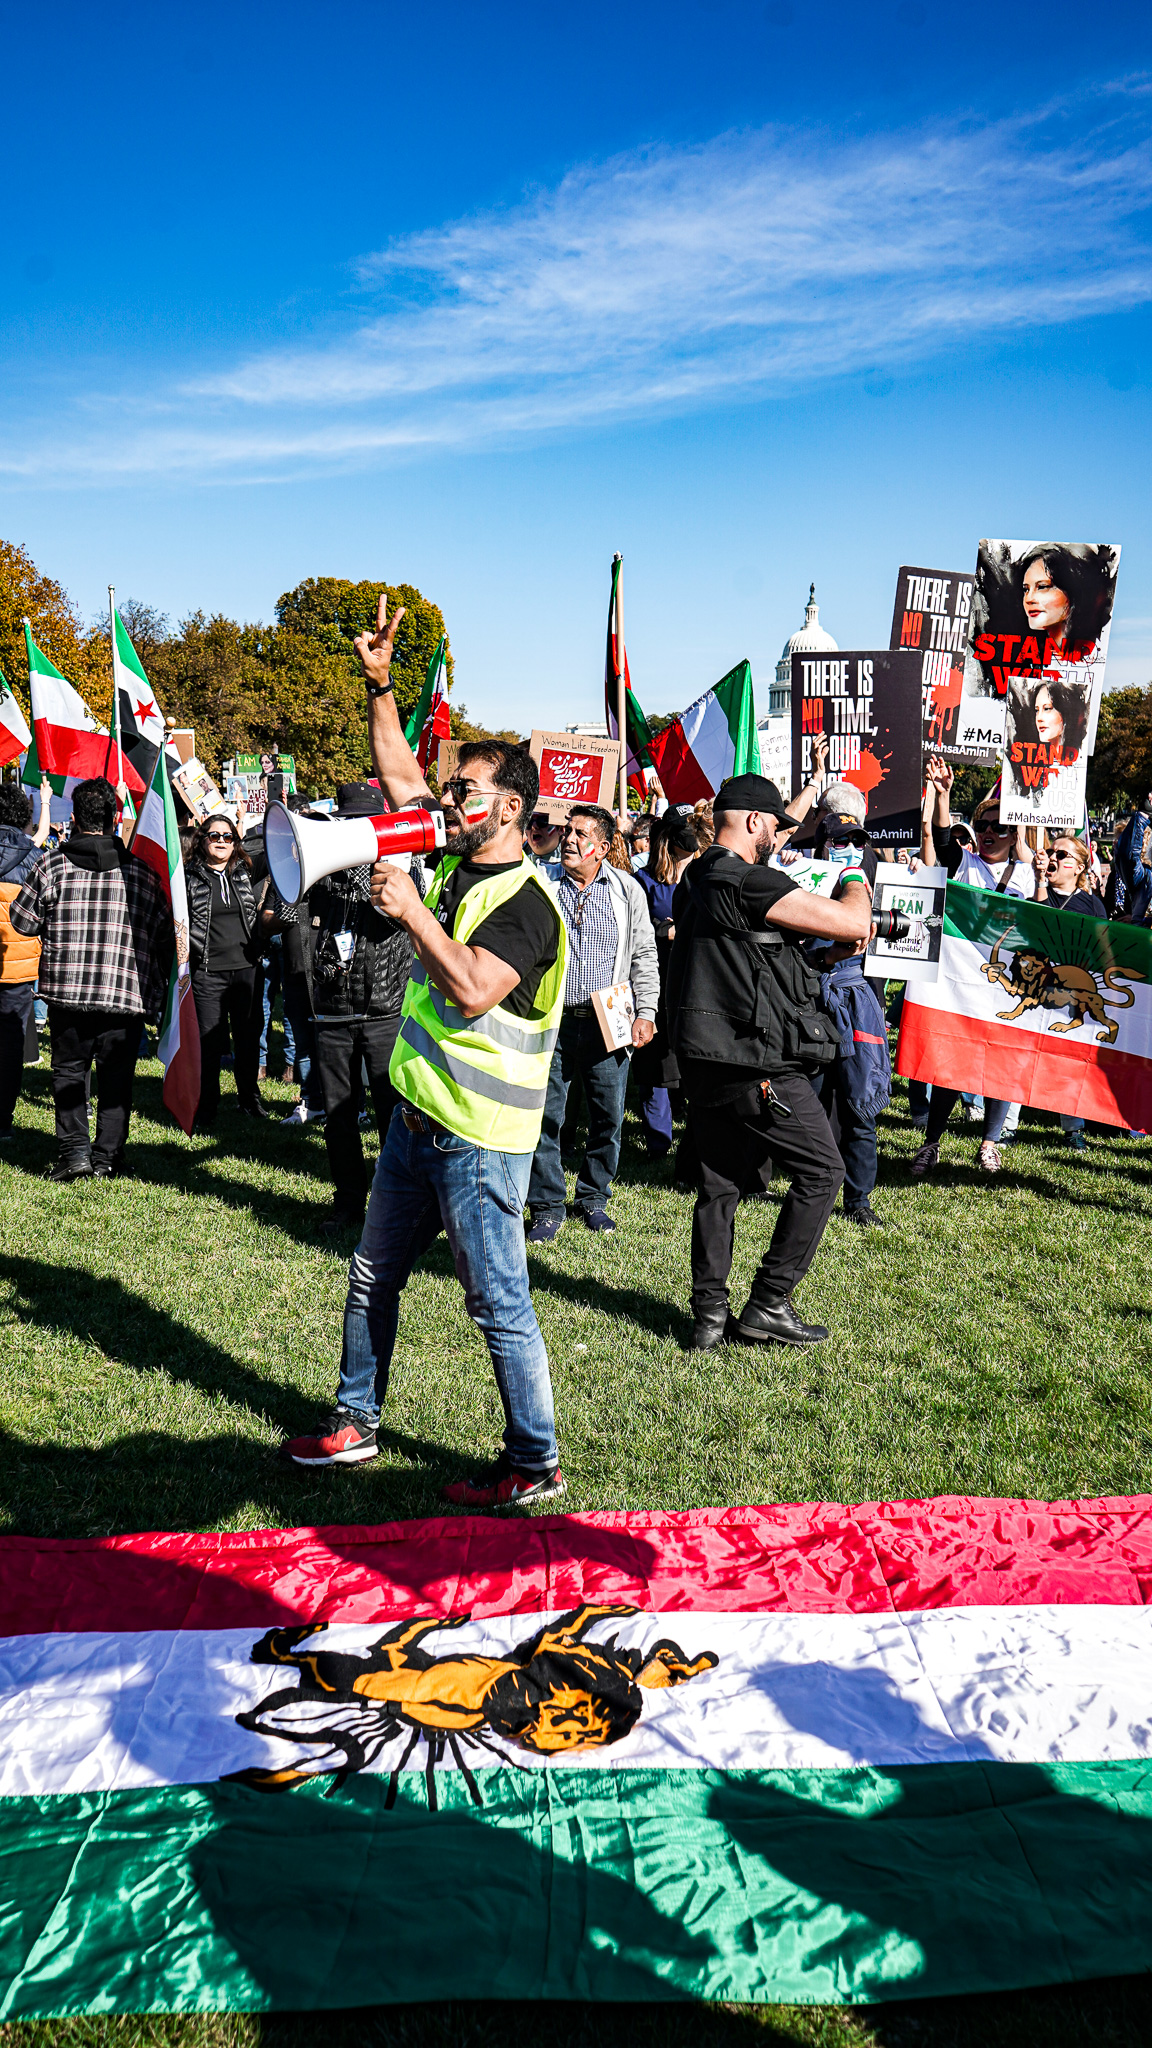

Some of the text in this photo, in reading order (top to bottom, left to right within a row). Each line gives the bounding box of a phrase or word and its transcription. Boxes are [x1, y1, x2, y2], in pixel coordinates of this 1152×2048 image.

[906, 575, 972, 617] THERE IS
[900, 611, 923, 647] NO
[972, 633, 1096, 667] STAND
[801, 660, 873, 696] THERE IS
[922, 650, 953, 687] OUR
[802, 698, 823, 734] NO
[831, 698, 878, 736] TIME,
[541, 735, 619, 754] Woman Life Freedom
[829, 735, 860, 770] OUR
[1010, 741, 1079, 767] STAND
[1020, 765, 1077, 790] WITH
[1048, 790, 1077, 814] US
[839, 815, 858, 826] M
[1006, 811, 1076, 826] #MahsaAmini
[867, 828, 914, 839] saAmini
[891, 894, 924, 915] IRAN
